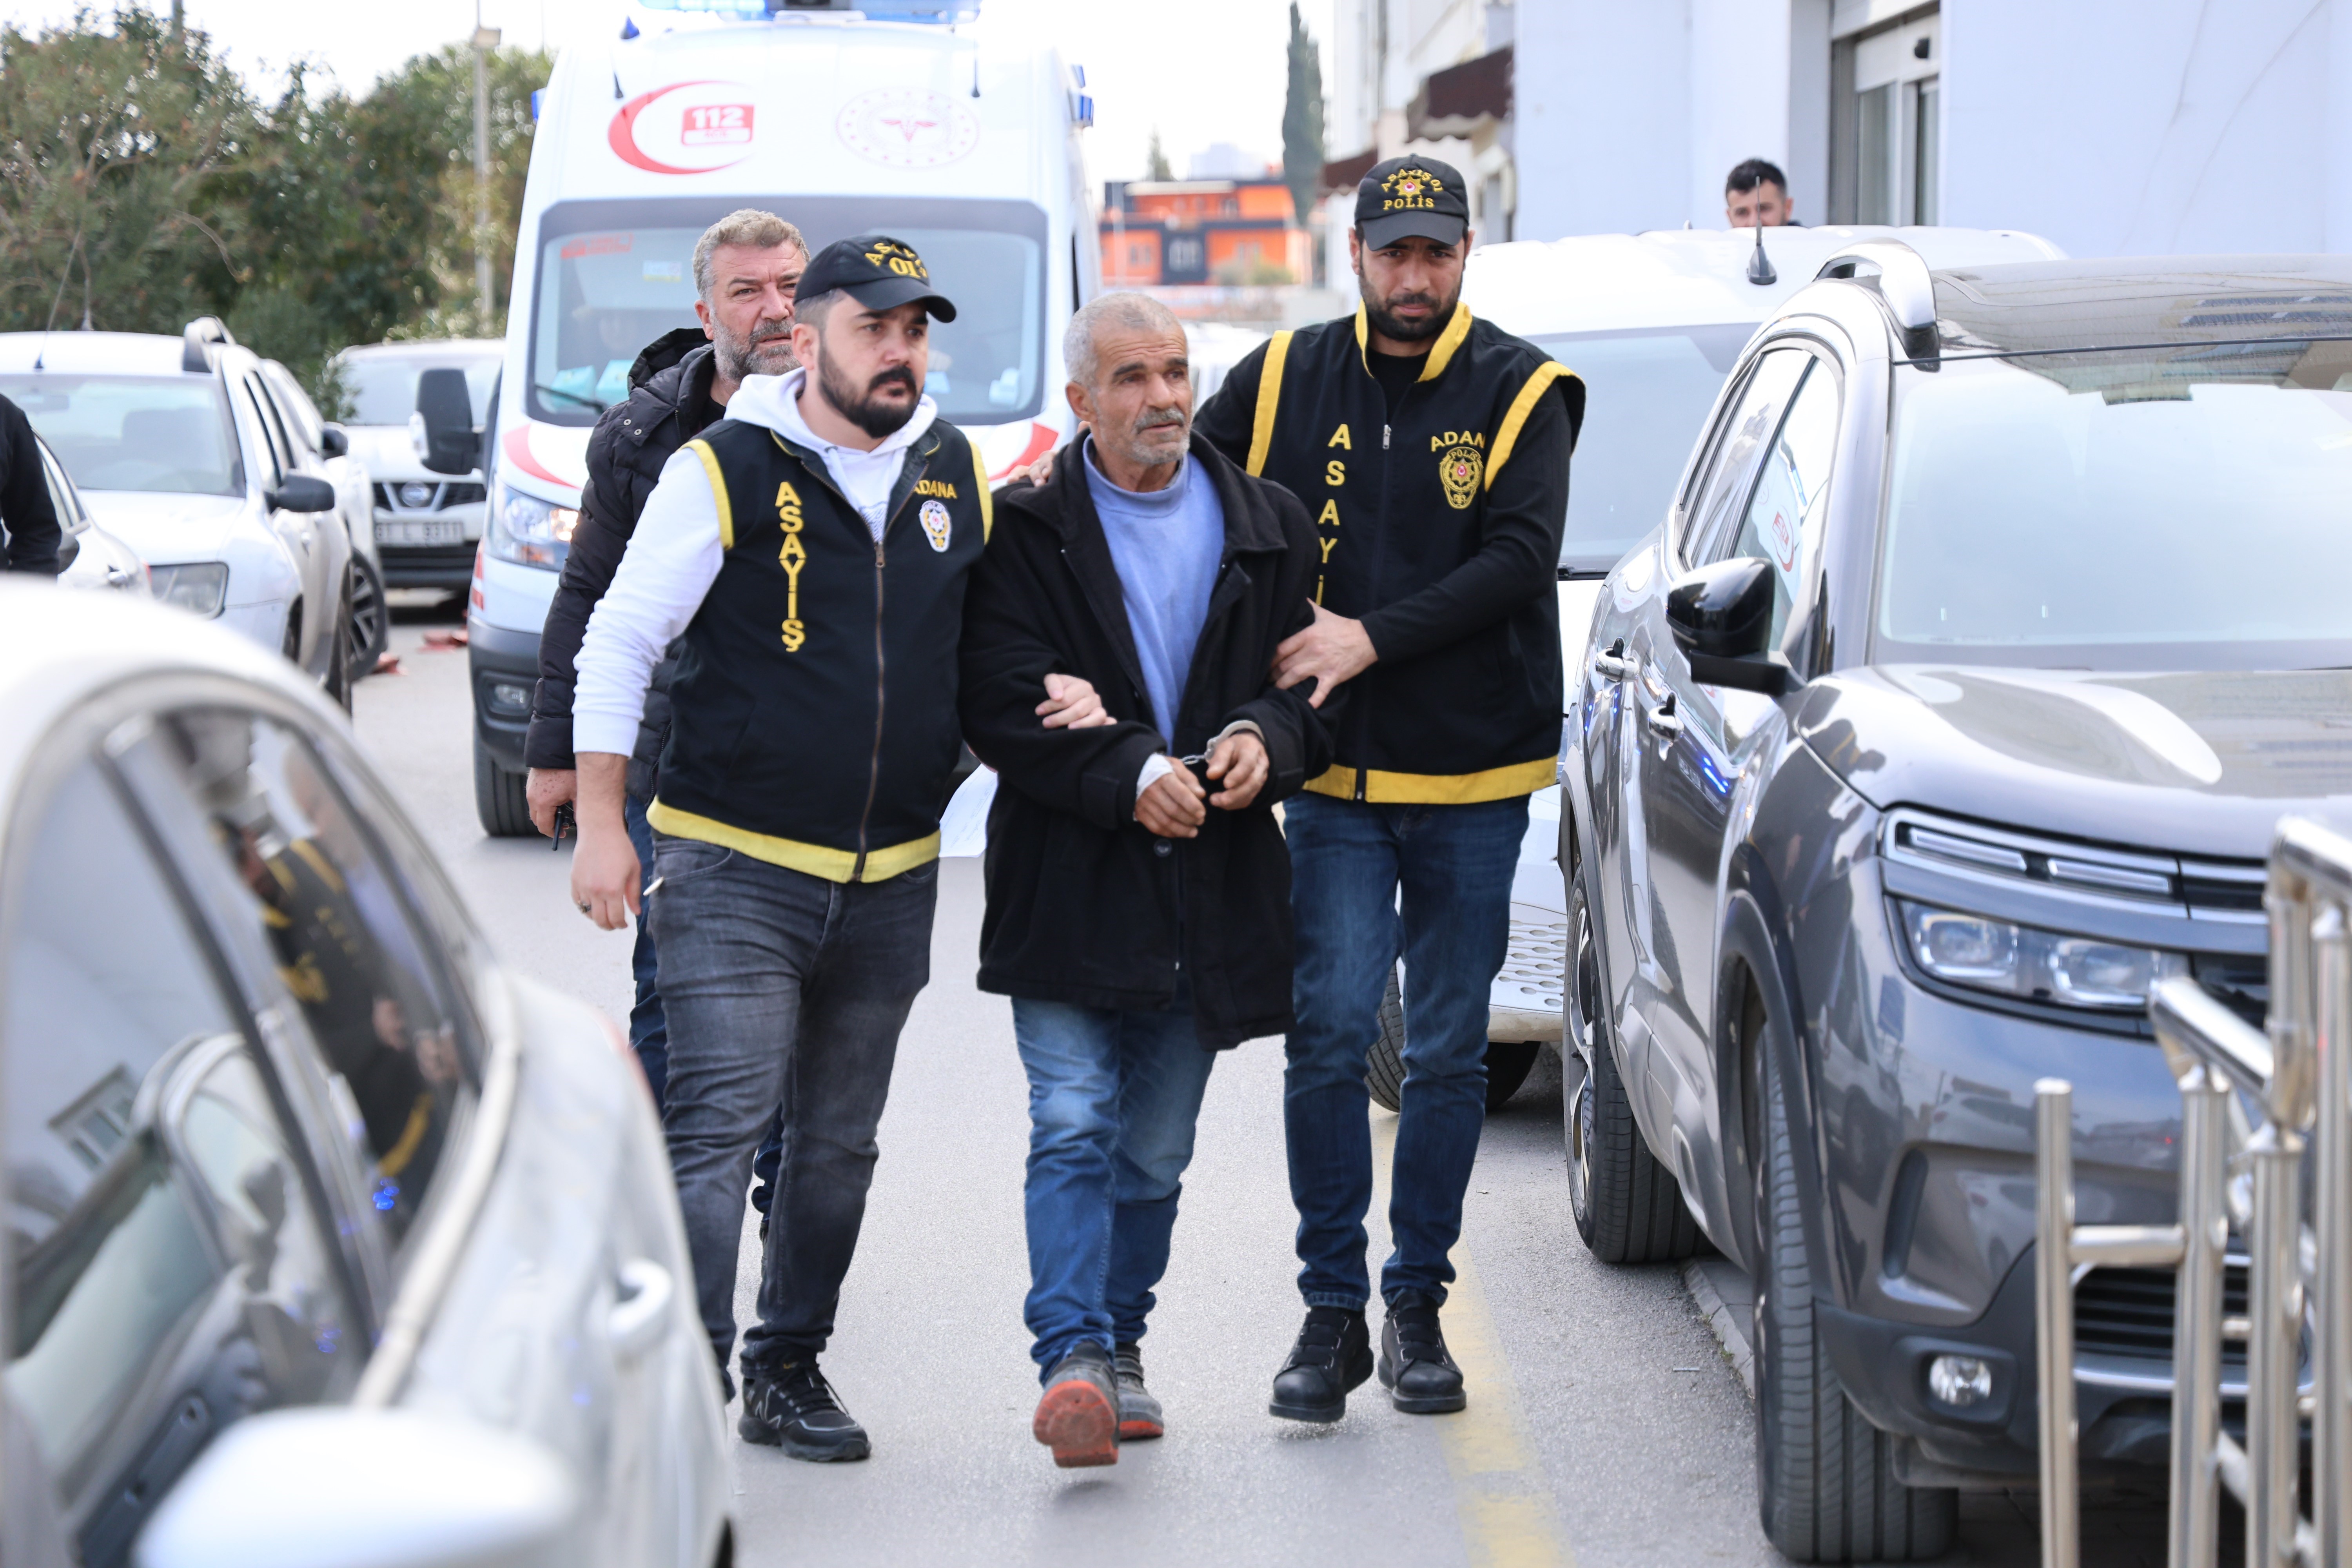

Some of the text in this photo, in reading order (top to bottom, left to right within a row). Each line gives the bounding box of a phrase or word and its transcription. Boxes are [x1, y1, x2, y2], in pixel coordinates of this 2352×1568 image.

[692, 106, 743, 128] 112
[1383, 195, 1434, 210] POLİS
[1431, 430, 1485, 452] ADAN
[1316, 424, 1352, 606] ASAYİ
[775, 481, 807, 652] ASAYİŞ
